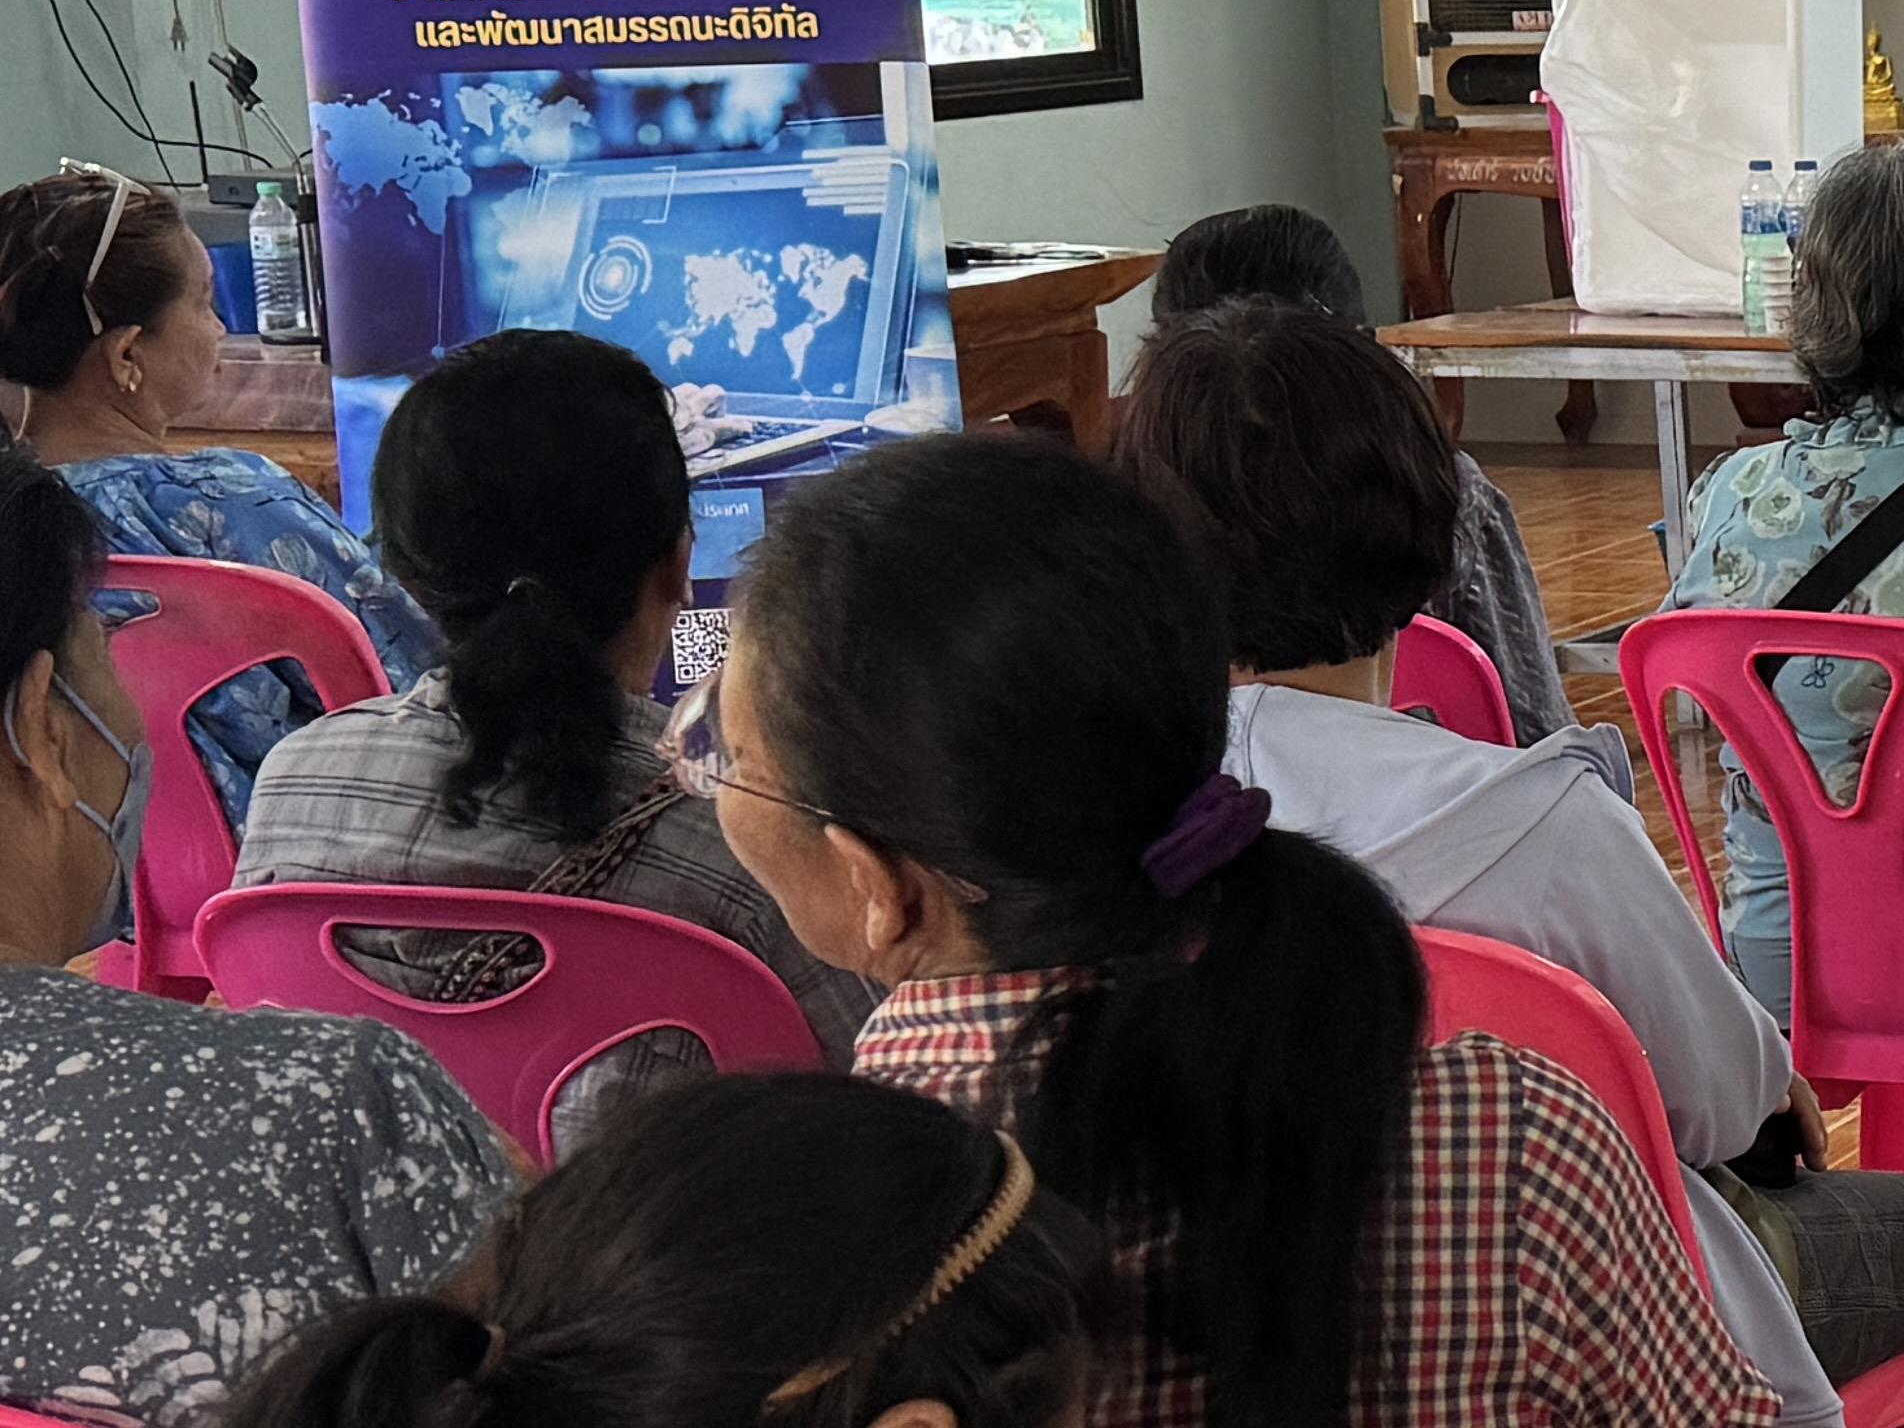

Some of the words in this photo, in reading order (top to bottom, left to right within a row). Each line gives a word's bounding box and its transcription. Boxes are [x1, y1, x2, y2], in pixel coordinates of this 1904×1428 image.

[415, 4, 818, 48] และพัฒนาสมรรถนะดิจิทัล
